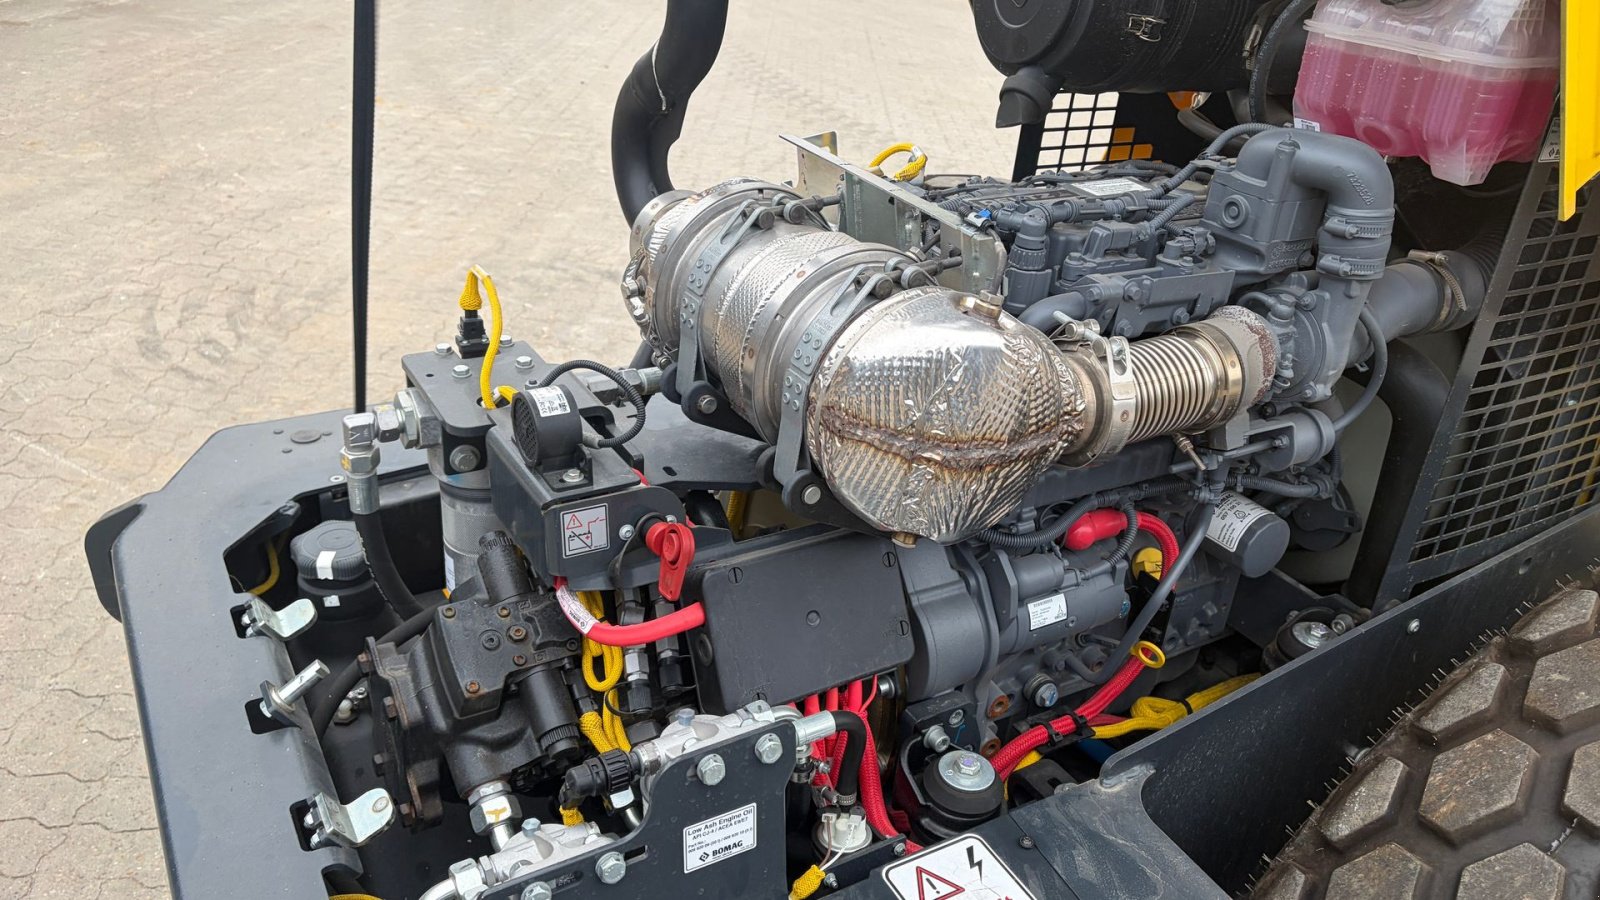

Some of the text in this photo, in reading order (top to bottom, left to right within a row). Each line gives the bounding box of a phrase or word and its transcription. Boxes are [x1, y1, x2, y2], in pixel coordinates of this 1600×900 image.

[687, 808, 753, 836] Low Ash Engine Oil
[718, 822, 733, 831] ACEA
[712, 840, 744, 857] BOMAG
